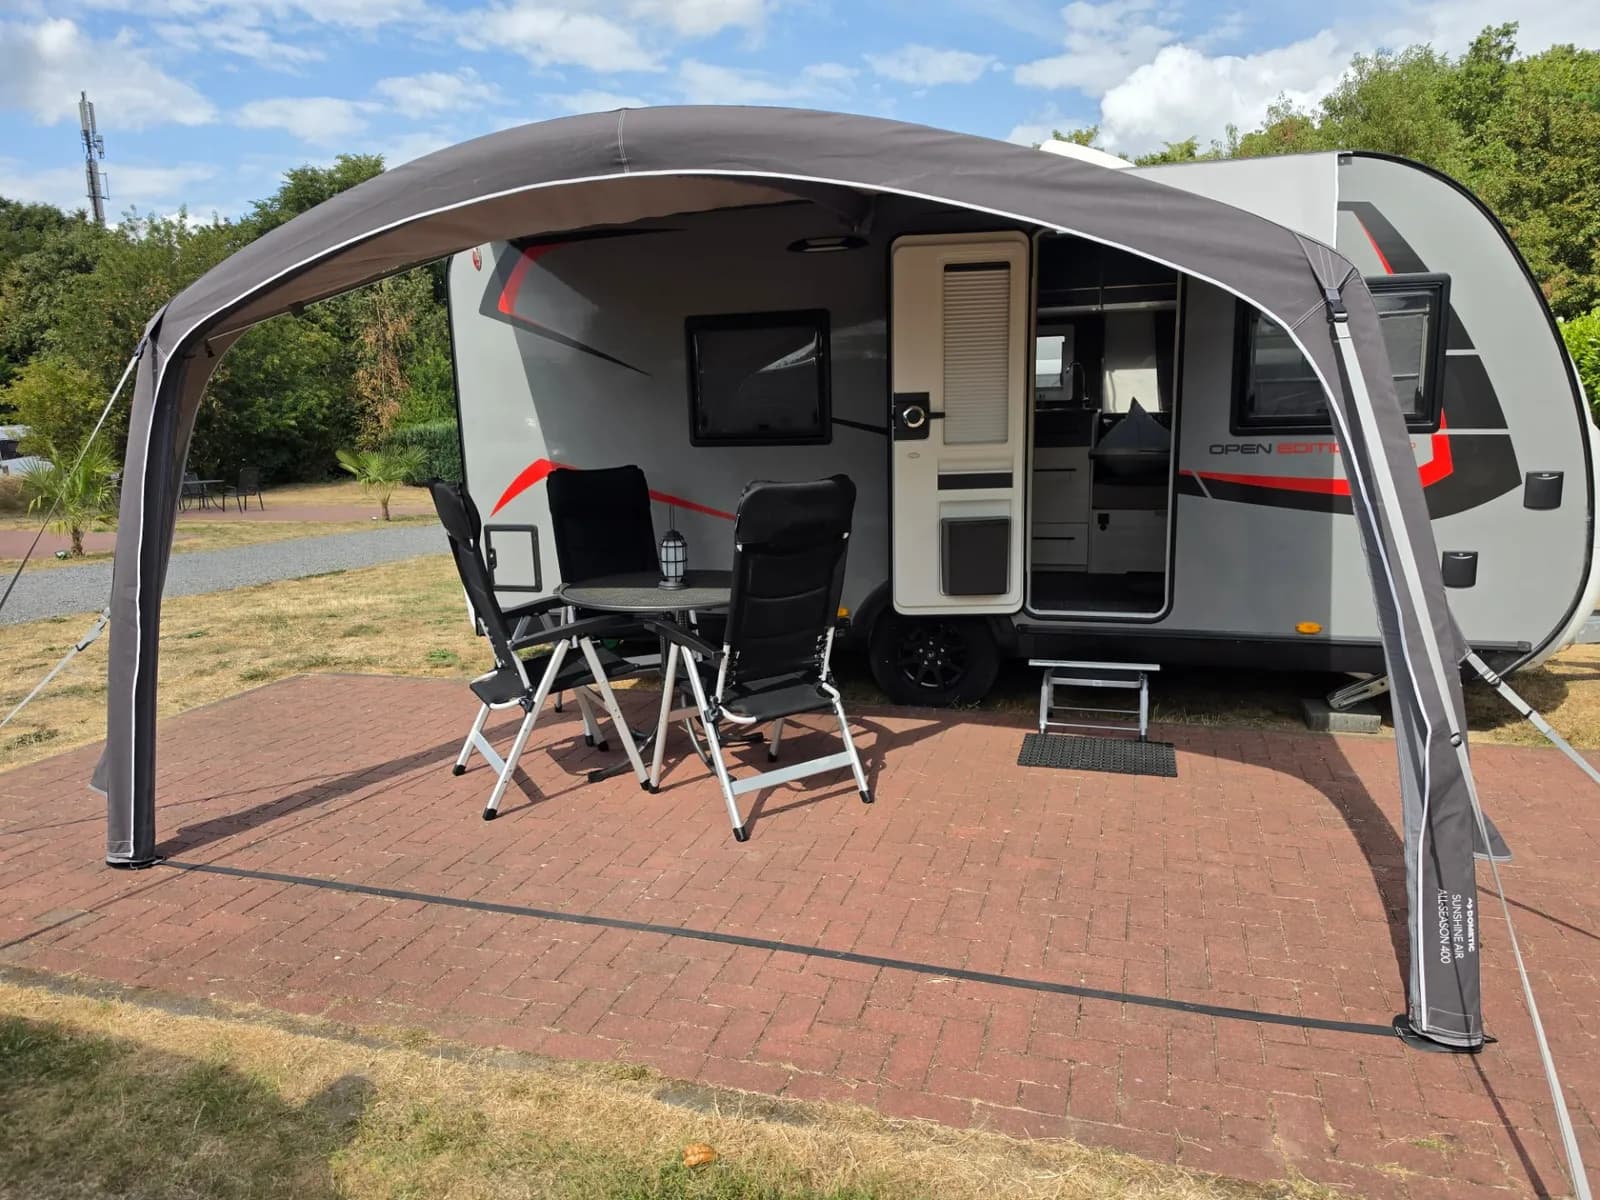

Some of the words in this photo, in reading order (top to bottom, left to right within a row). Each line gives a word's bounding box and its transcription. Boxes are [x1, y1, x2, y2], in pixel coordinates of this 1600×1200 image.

[1209, 443, 1273, 455] OPEN
[1438, 888, 1450, 944] ALL-SEASON
[1452, 894, 1463, 942] SUNSHINE
[1467, 910, 1475, 953] DOMETIC
[1440, 945, 1452, 964] 400
[1454, 943, 1464, 960] AIR
